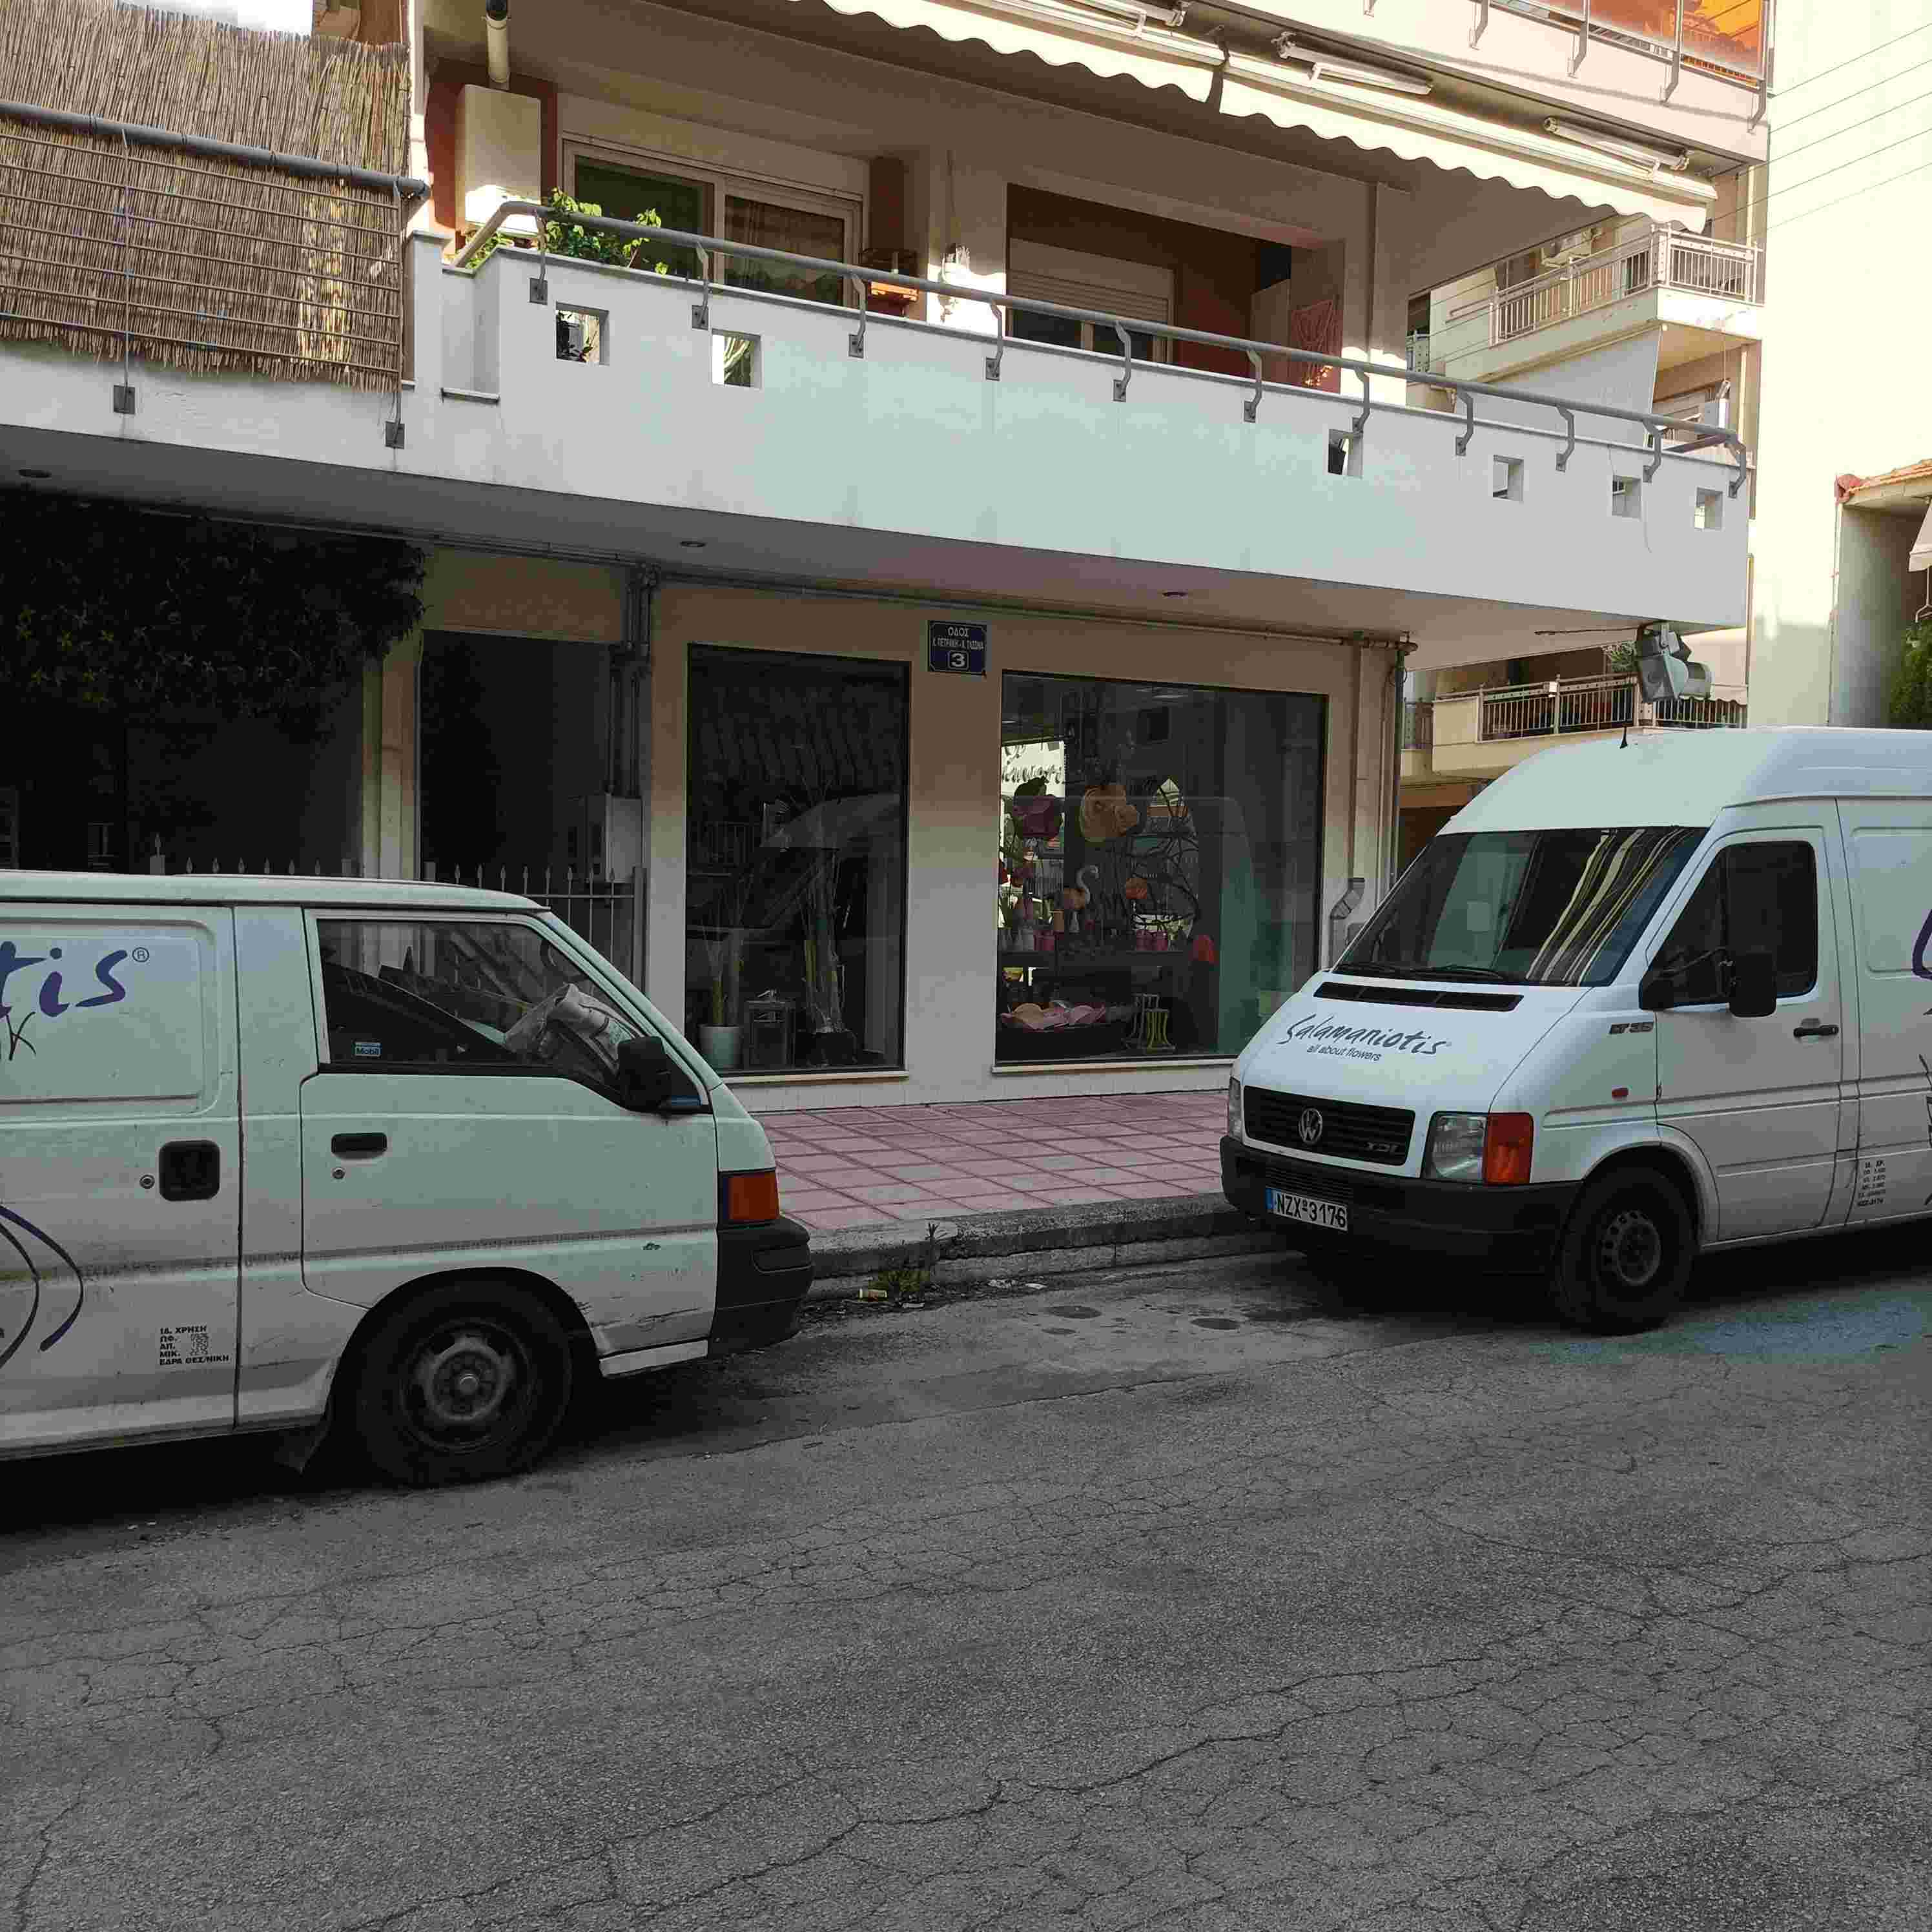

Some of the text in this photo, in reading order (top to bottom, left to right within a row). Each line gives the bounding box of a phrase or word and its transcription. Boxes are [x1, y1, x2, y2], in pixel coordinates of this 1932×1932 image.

[951, 653, 965, 667] 3
[1276, 1013, 1448, 1054] Salamaniotis
[1307, 1044, 1382, 1062] all about flowers
